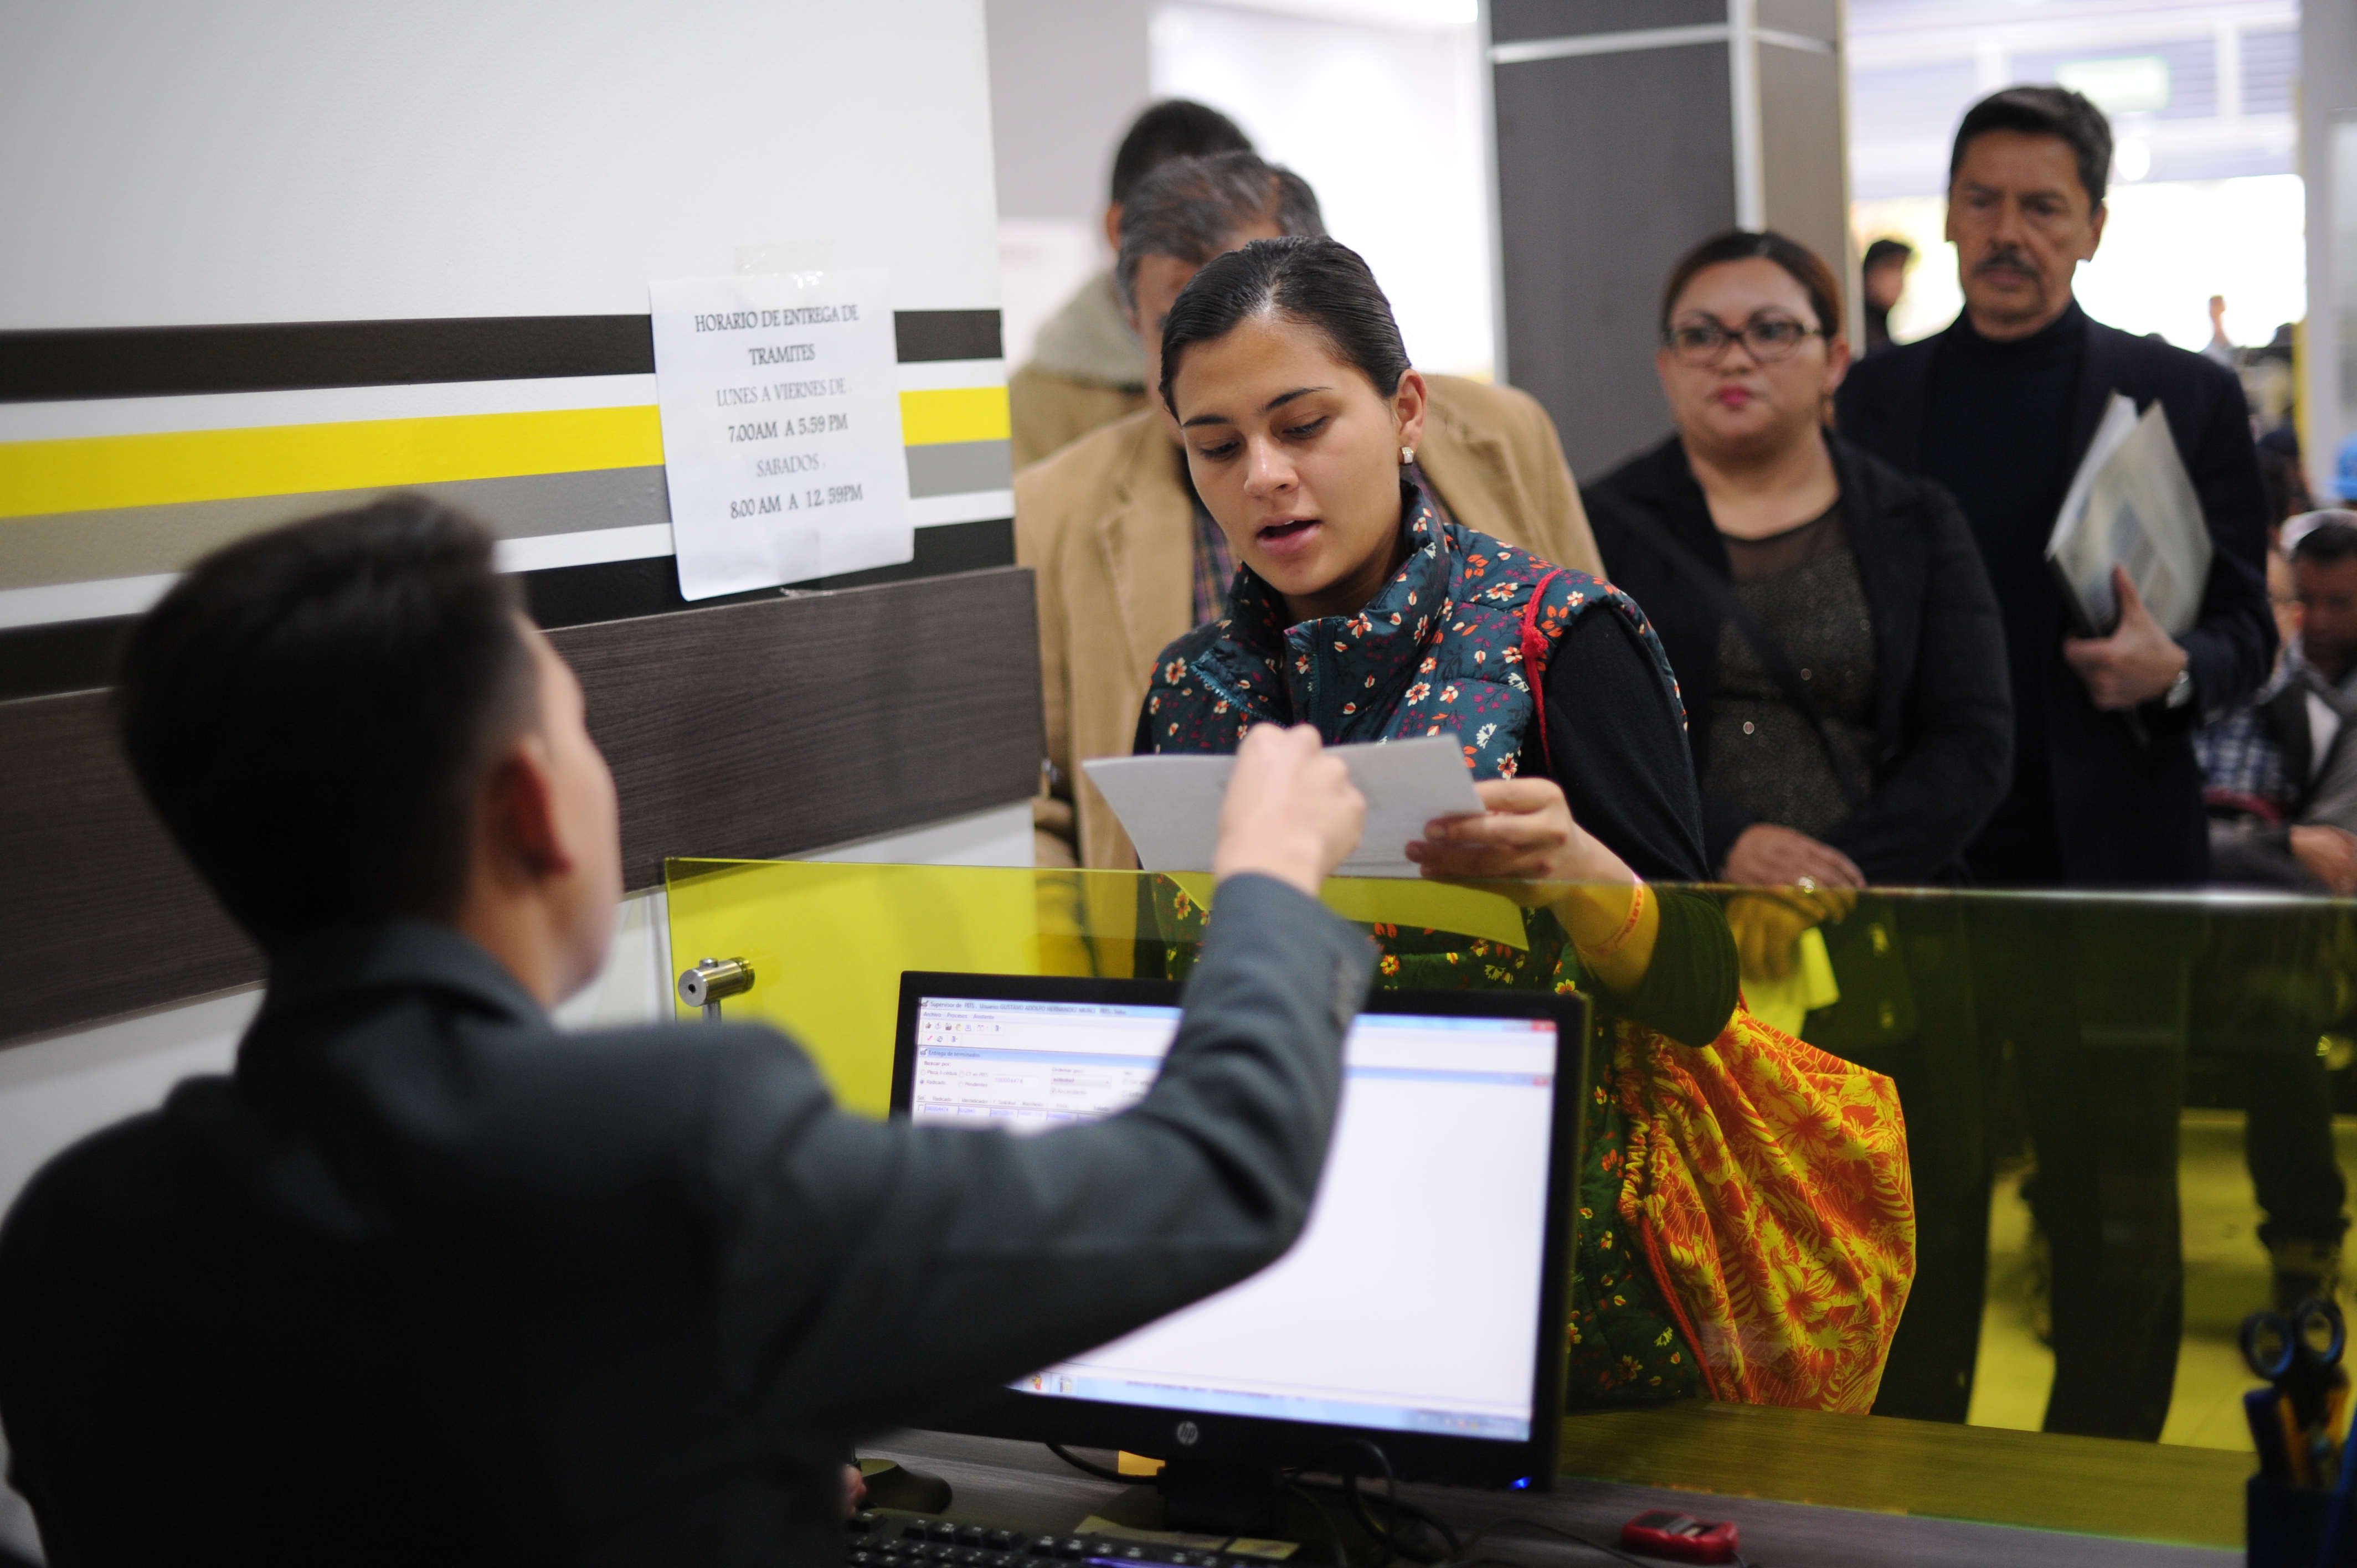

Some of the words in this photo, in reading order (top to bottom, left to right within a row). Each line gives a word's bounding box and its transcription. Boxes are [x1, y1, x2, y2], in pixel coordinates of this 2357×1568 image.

[695, 311, 758, 332] HORARIO
[761, 310, 781, 327] DE
[784, 306, 840, 326] ENTREGA
[842, 305, 860, 322] DE
[749, 343, 815, 365] TRAMITES
[717, 386, 758, 406] LUNES
[761, 385, 771, 402] A
[774, 380, 826, 401] VIERNES
[785, 420, 795, 436] A
[828, 414, 848, 431] PM
[759, 495, 782, 514] AM
[789, 493, 799, 510] A
